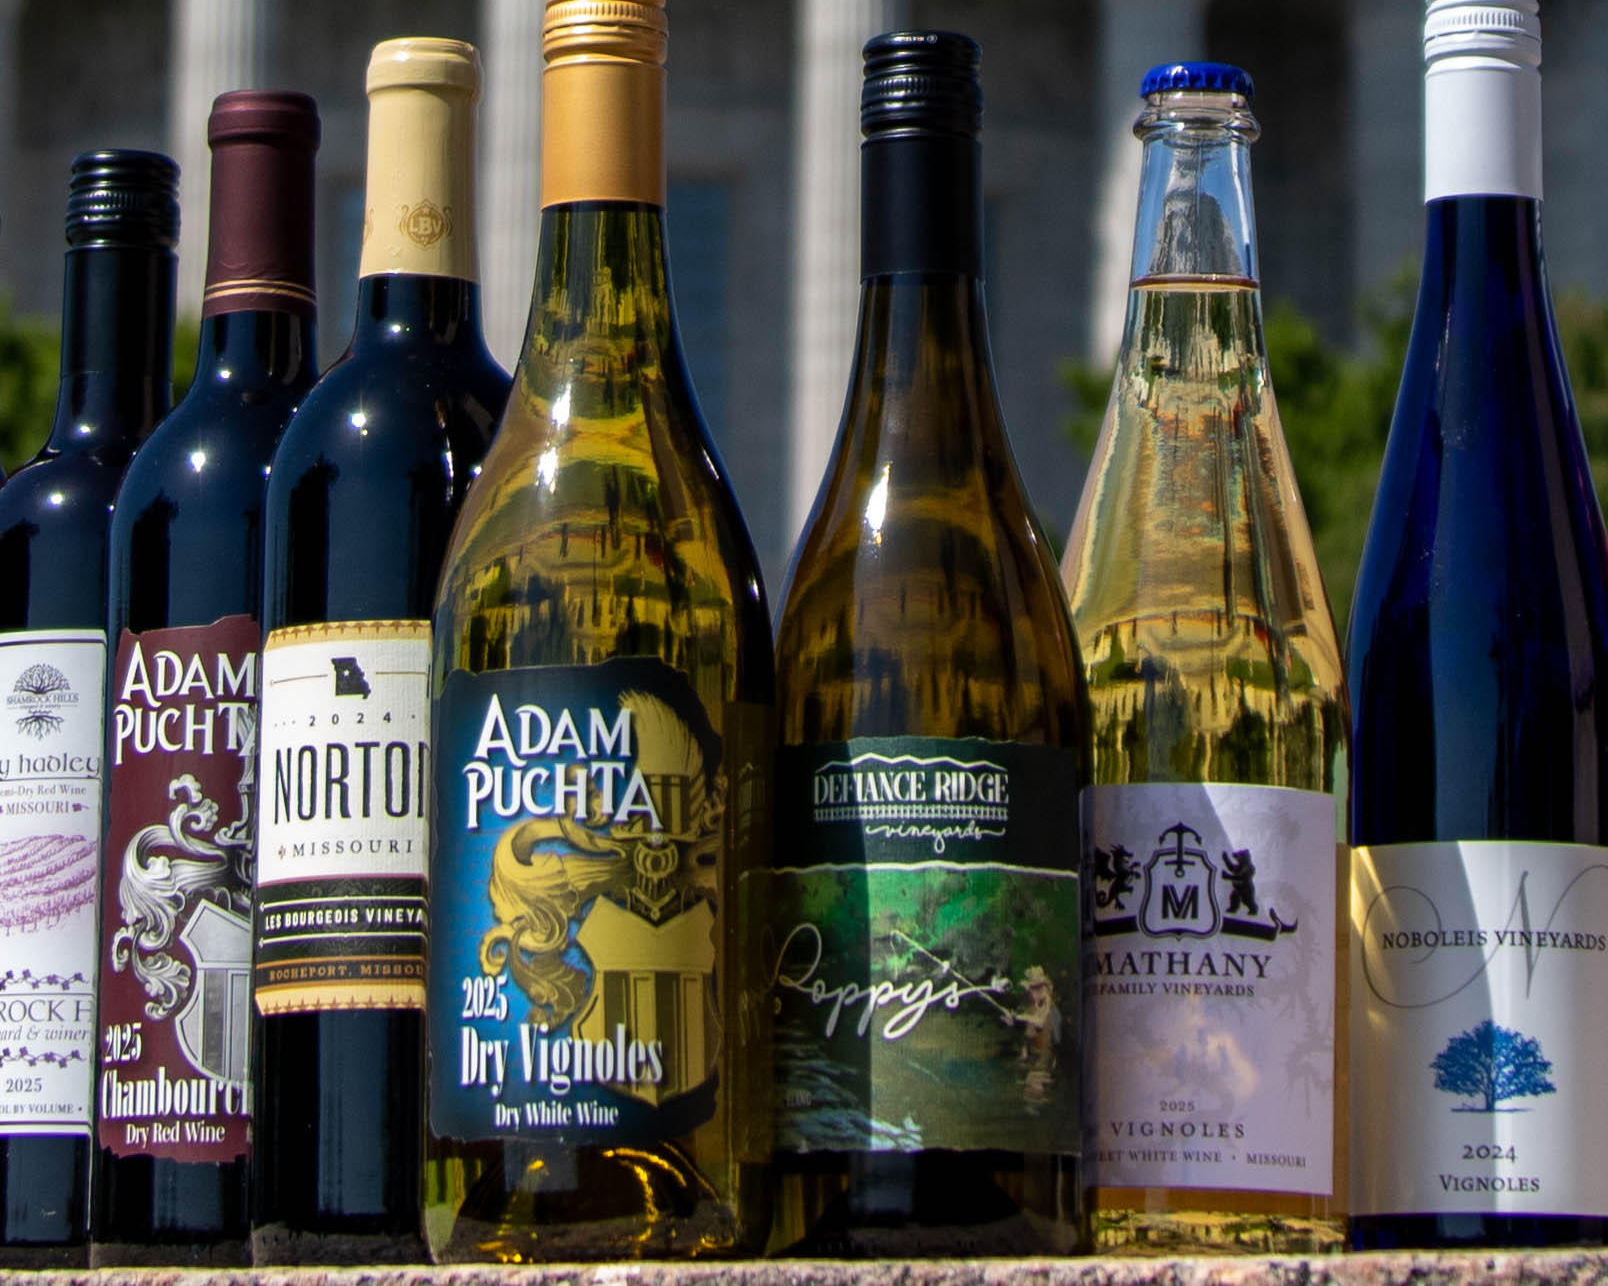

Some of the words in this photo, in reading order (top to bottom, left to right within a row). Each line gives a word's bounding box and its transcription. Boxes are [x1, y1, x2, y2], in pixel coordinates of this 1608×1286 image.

[121, 640, 256, 707] ADAM
[309, 711, 391, 727] 2024
[474, 693, 632, 767] ADAM
[37, 785, 56, 795] Red
[60, 784, 87, 795] Wine
[462, 760, 663, 831] PUCHTA
[814, 771, 926, 804] DEFIANCE
[935, 772, 1009, 805] RIDGE
[6, 801, 69, 815] MISSOURI
[293, 838, 413, 858] MISSOURI
[265, 914, 281, 931] LES
[285, 908, 358, 928] BOURGEOIS
[1382, 930, 1488, 950] NOBOLEIS
[1495, 930, 1607, 951] VINEYARDS
[461, 973, 508, 1021] 2025
[1099, 983, 1157, 996] FAMILY
[1163, 983, 1255, 996] VINEYARDS
[26, 1027, 39, 1040] &
[104, 1022, 142, 1062] 2025
[460, 1027, 509, 1097] Dry
[520, 1023, 663, 1095] Vignoles
[6, 1078, 42, 1093] 2025
[28, 1103, 74, 1114] VOLUME
[495, 1103, 521, 1131] Dry
[526, 1100, 572, 1126] White
[577, 1100, 619, 1127] Wine
[1160, 1101, 1195, 1112] 2025
[126, 1123, 149, 1148] Dry
[152, 1120, 180, 1143] Red
[185, 1119, 225, 1143] Wine
[1110, 1122, 1245, 1139] VIGNOLES
[1127, 1150, 1177, 1163] WHITE
[1183, 1150, 1222, 1163] WINE
[1247, 1152, 1306, 1168] MISSOURI
[1462, 1144, 1518, 1163] 2024
[1440, 1174, 1541, 1192] VIGNOLES
